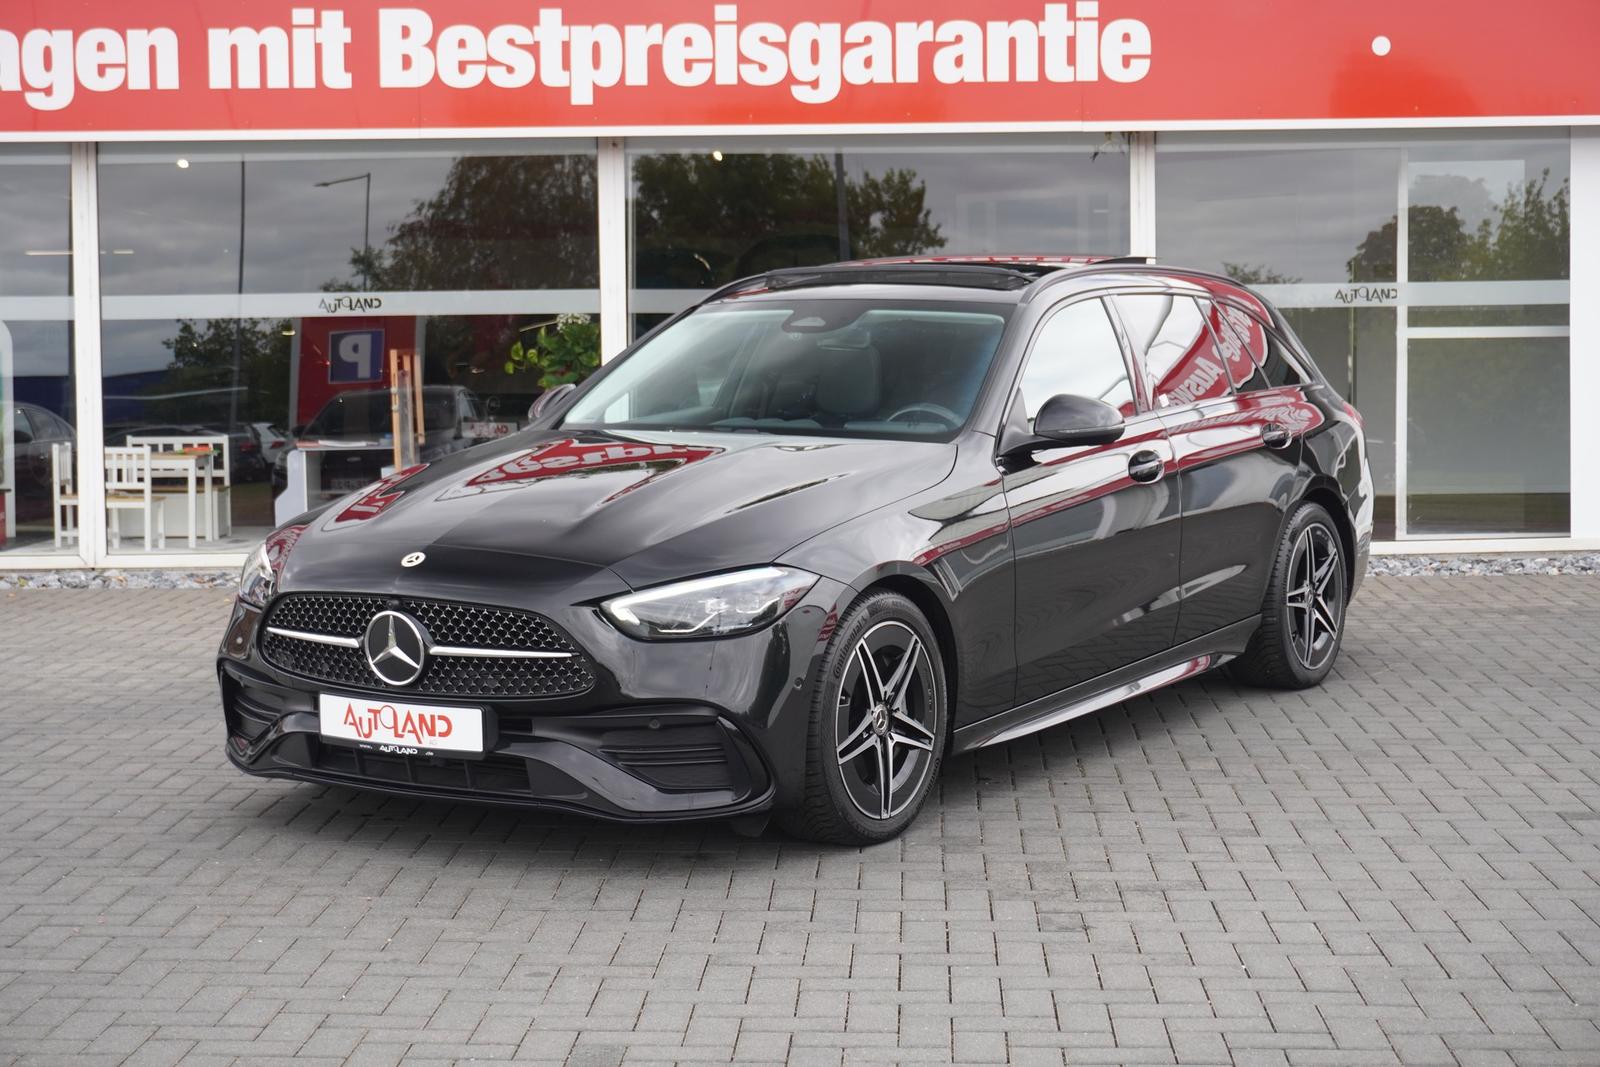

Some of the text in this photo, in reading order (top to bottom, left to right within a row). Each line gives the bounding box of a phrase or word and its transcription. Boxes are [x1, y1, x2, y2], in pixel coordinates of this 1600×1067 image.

[208, 8, 353, 89] mit
[378, 1, 1152, 105] Bestpreisgarantie
[344, 703, 453, 745] AUTOLAND
[379, 744, 418, 755] AUTOLAND
